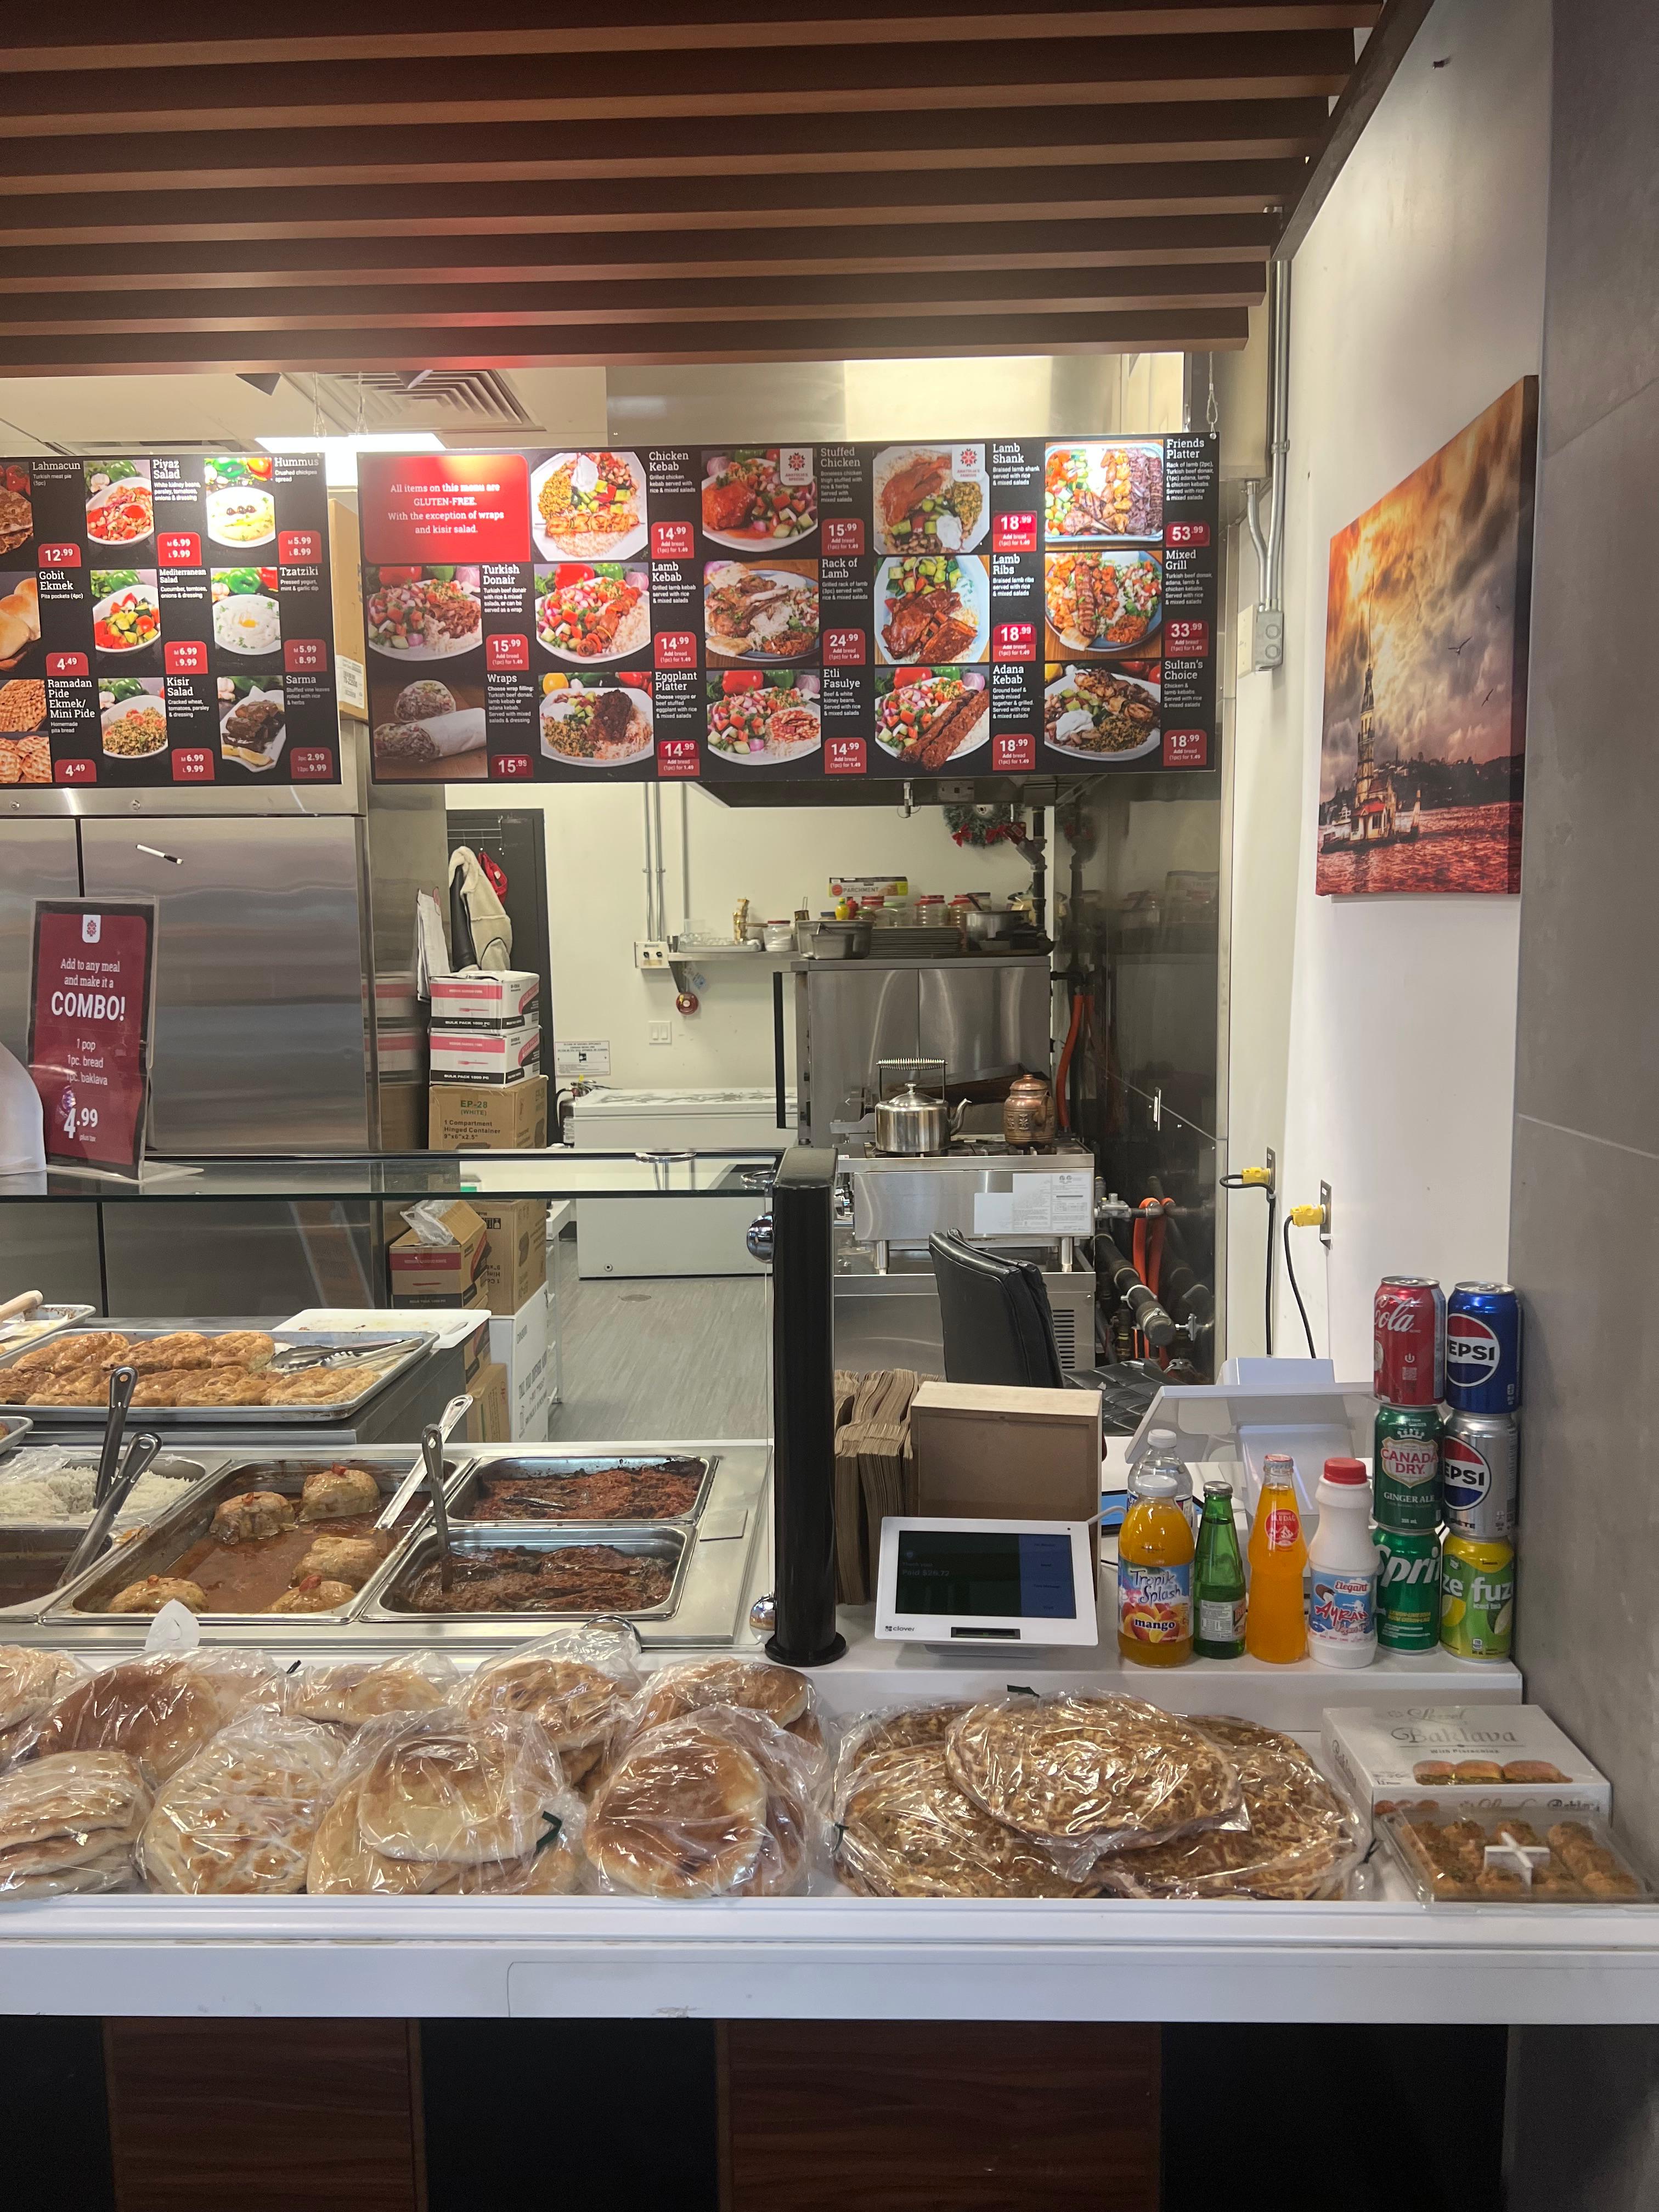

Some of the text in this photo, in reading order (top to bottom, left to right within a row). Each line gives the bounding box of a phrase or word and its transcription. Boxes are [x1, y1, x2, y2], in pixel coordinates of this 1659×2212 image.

[993, 443, 1020, 453] Lamb
[1167, 438, 1204, 448] Friends
[649, 451, 689, 460] Chicken
[821, 447, 855, 456] Stuffed
[1166, 449, 1199, 459] Platter
[274, 457, 318, 467] Hummus
[821, 458, 860, 467] Chicken
[993, 453, 1024, 464] Shank
[32, 461, 81, 470] Lahmacun
[153, 459, 179, 470] Piyaz
[650, 461, 679, 471] Kebab
[154, 469, 180, 479] Salad
[442, 483, 459, 492] this
[414, 497, 477, 506] GLUTEN-FREE.
[426, 511, 466, 521] exception
[469, 510, 477, 519] of
[478, 512, 504, 521] wraps
[1001, 516, 1031, 530] 18.99
[433, 525, 452, 533] kisir
[454, 524, 478, 533] salad.
[658, 527, 686, 540] 14.99
[829, 523, 856, 536] 15.99
[1172, 526, 1203, 541] 53.99
[45, 549, 72, 561] 12.99
[993, 554, 1020, 564] Lamb
[1166, 550, 1195, 559] Mixed
[652, 561, 679, 571] Lamb
[822, 558, 857, 568] Rack of
[1166, 560, 1187, 570] Grill
[280, 567, 318, 576] Tzatziki
[482, 564, 520, 574] Turkish
[822, 568, 848, 578] Lamb
[993, 565, 1014, 574] Ribs
[40, 571, 65, 580] Gobit
[483, 574, 515, 584] Donair
[652, 572, 681, 582] Kebab
[40, 580, 74, 590] Ekmek
[1001, 627, 1031, 641] 18.99
[1171, 623, 1202, 637] 33.99
[661, 637, 689, 650] 14.99
[830, 634, 858, 646] 24.99
[493, 639, 521, 652] 15.99
[57, 658, 77, 670] 4.49
[993, 664, 1024, 674] Adana
[1165, 660, 1203, 669] Sultan's
[656, 671, 697, 682] Eggplant
[823, 668, 839, 678] Etli
[1165, 670, 1197, 680] Choice
[48, 679, 92, 687] Ramadan
[167, 677, 189, 686] Kisir
[286, 675, 316, 684] Sarma
[487, 674, 517, 684] Wraps
[824, 679, 860, 689] Fasulye
[993, 674, 1023, 684] Kebab
[167, 687, 193, 696] Salad
[656, 682, 687, 691] Platter
[48, 689, 69, 698] Pide
[49, 699, 86, 708] Ekmek/
[50, 709, 95, 718] Mini Pide
[1000, 739, 1028, 752] 18.99
[1171, 735, 1199, 747] 18.99
[665, 743, 694, 756] 14.99
[832, 743, 859, 755] 14.99
[66, 764, 85, 776] 4.49
[499, 760, 527, 772] 15.99
[60, 958, 120, 973] Add to any meal
[64, 975, 114, 988] and make it a
[52, 991, 125, 1021] COMBO!
[77, 1039, 95, 1052] 1 pop
[67, 1054, 103, 1068] 1pc. bread
[80, 1072, 108, 1085] baklava
[460, 1100, 488, 1109] EP-28
[64, 1108, 98, 1139] 4.99
[1448, 1340, 1494, 1361] EPSI
[1381, 1449, 1438, 1463] CANADA
[1444, 1463, 1484, 1486] EPSI
[1384, 1492, 1418, 1503] GINGER
[1130, 1570, 1175, 1586] Tropik
[1334, 1581, 1368, 1593] Elegant
[1471, 1577, 1514, 1602] fuz
[1139, 1584, 1181, 1606] Splash
[1134, 1619, 1175, 1631] mango
[1391, 1727, 1517, 1743] Baklava
